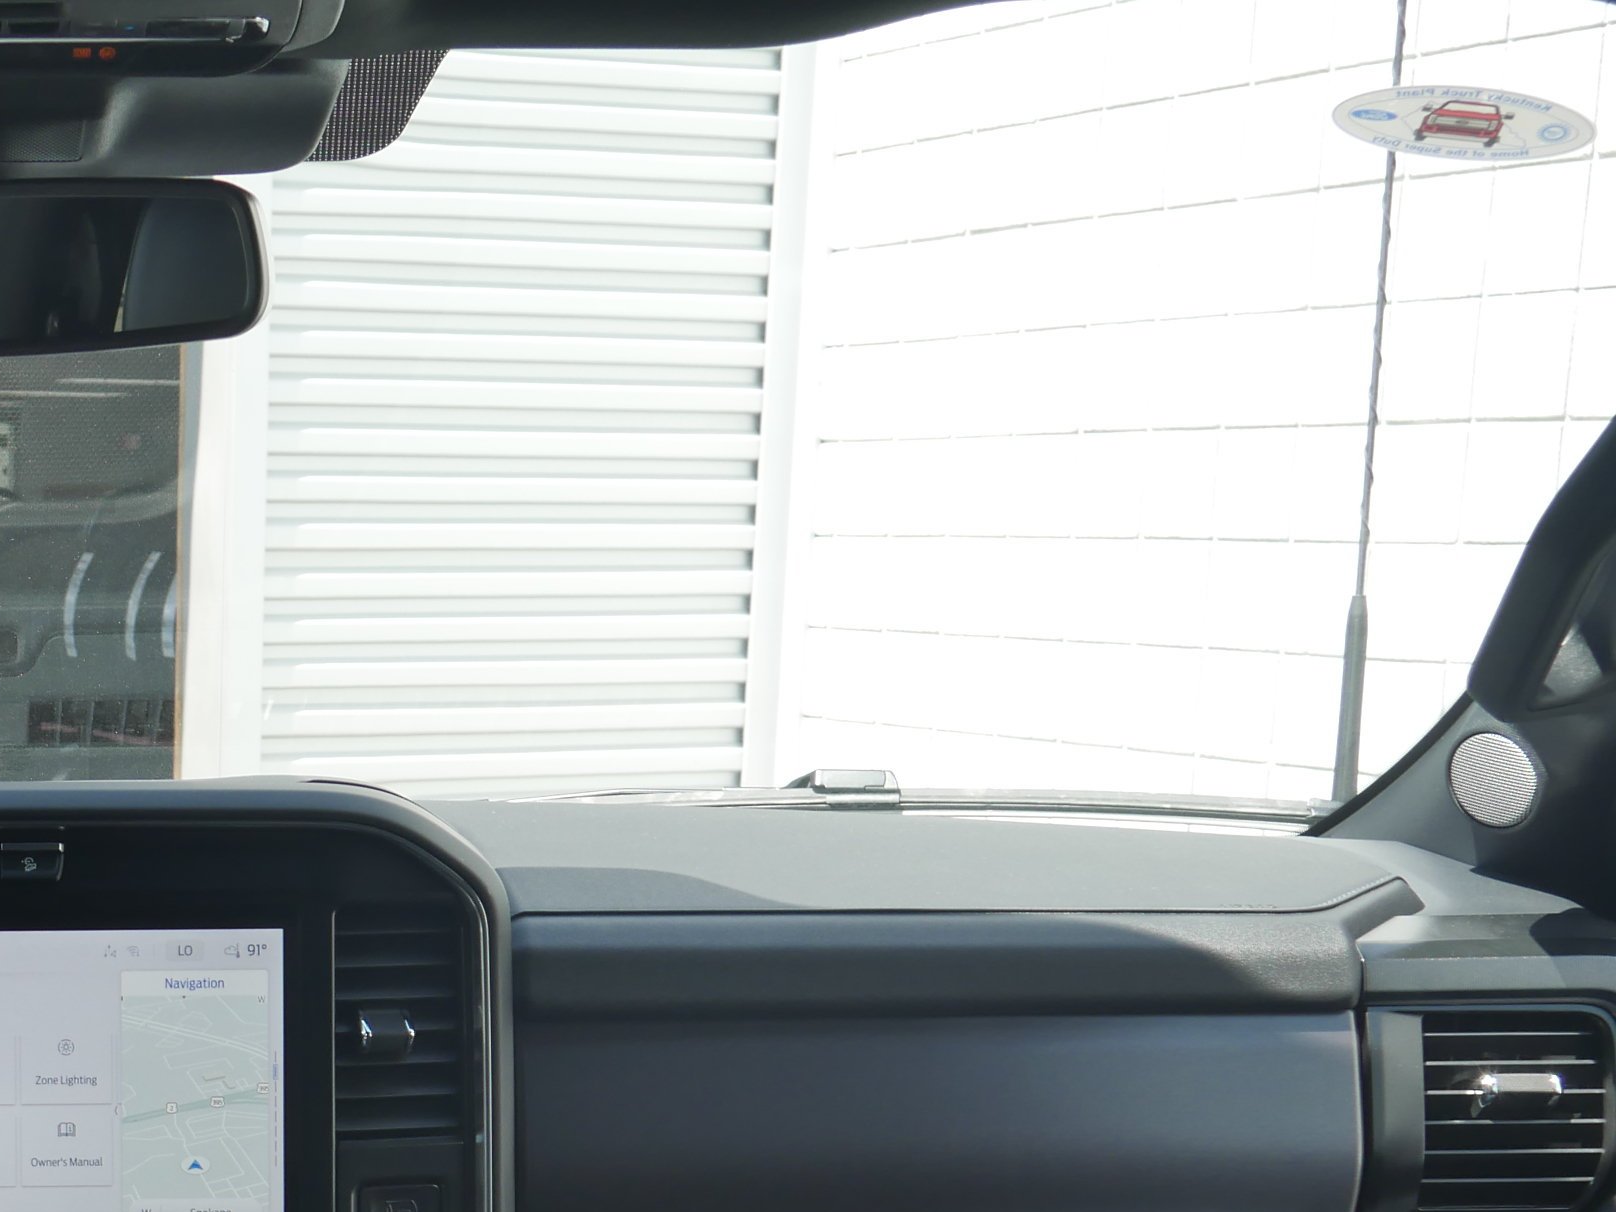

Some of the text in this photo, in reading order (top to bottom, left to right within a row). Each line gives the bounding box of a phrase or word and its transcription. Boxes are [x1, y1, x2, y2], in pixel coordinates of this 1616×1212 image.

[177, 944, 193, 957] LO
[247, 943, 267, 956] 91°
[164, 977, 225, 991] Navigation
[35, 1075, 97, 1087] Zone Lighting
[30, 1157, 103, 1167] Owner's Manual
